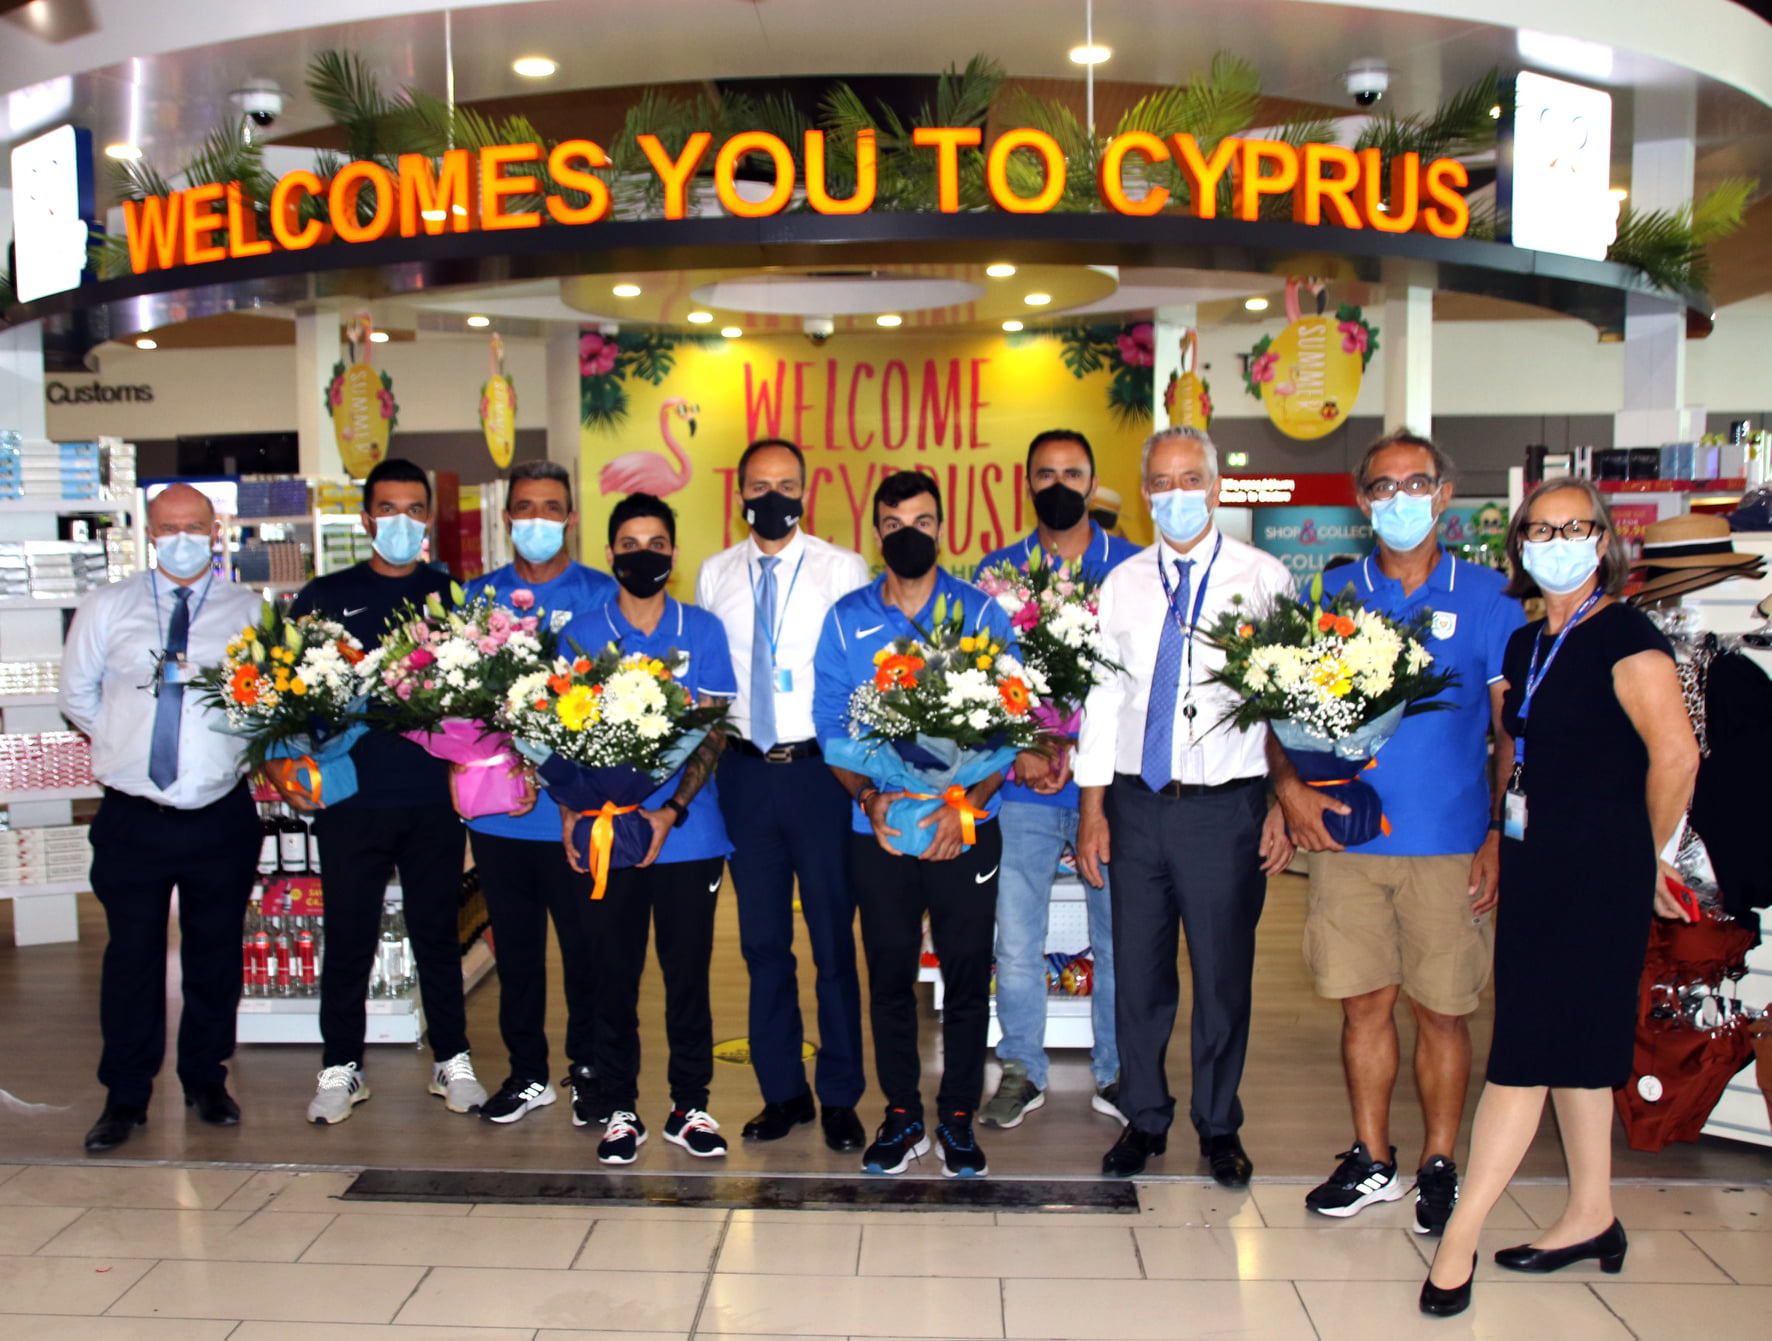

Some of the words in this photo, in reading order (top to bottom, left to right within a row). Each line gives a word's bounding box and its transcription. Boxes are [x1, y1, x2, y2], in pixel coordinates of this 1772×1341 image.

[123, 139, 613, 274] WELCOMES
[637, 129, 877, 220] YOU
[913, 127, 1067, 214] TO
[1100, 130, 1470, 238] CYPRUS
[46, 380, 154, 405] Customs
[744, 357, 992, 453] WELCOME
[1298, 324, 1326, 412] SUMMER
[804, 462, 1024, 556] CYUS!
[1265, 526, 1299, 539] SHOP
[1318, 525, 1374, 539] COLLECT
